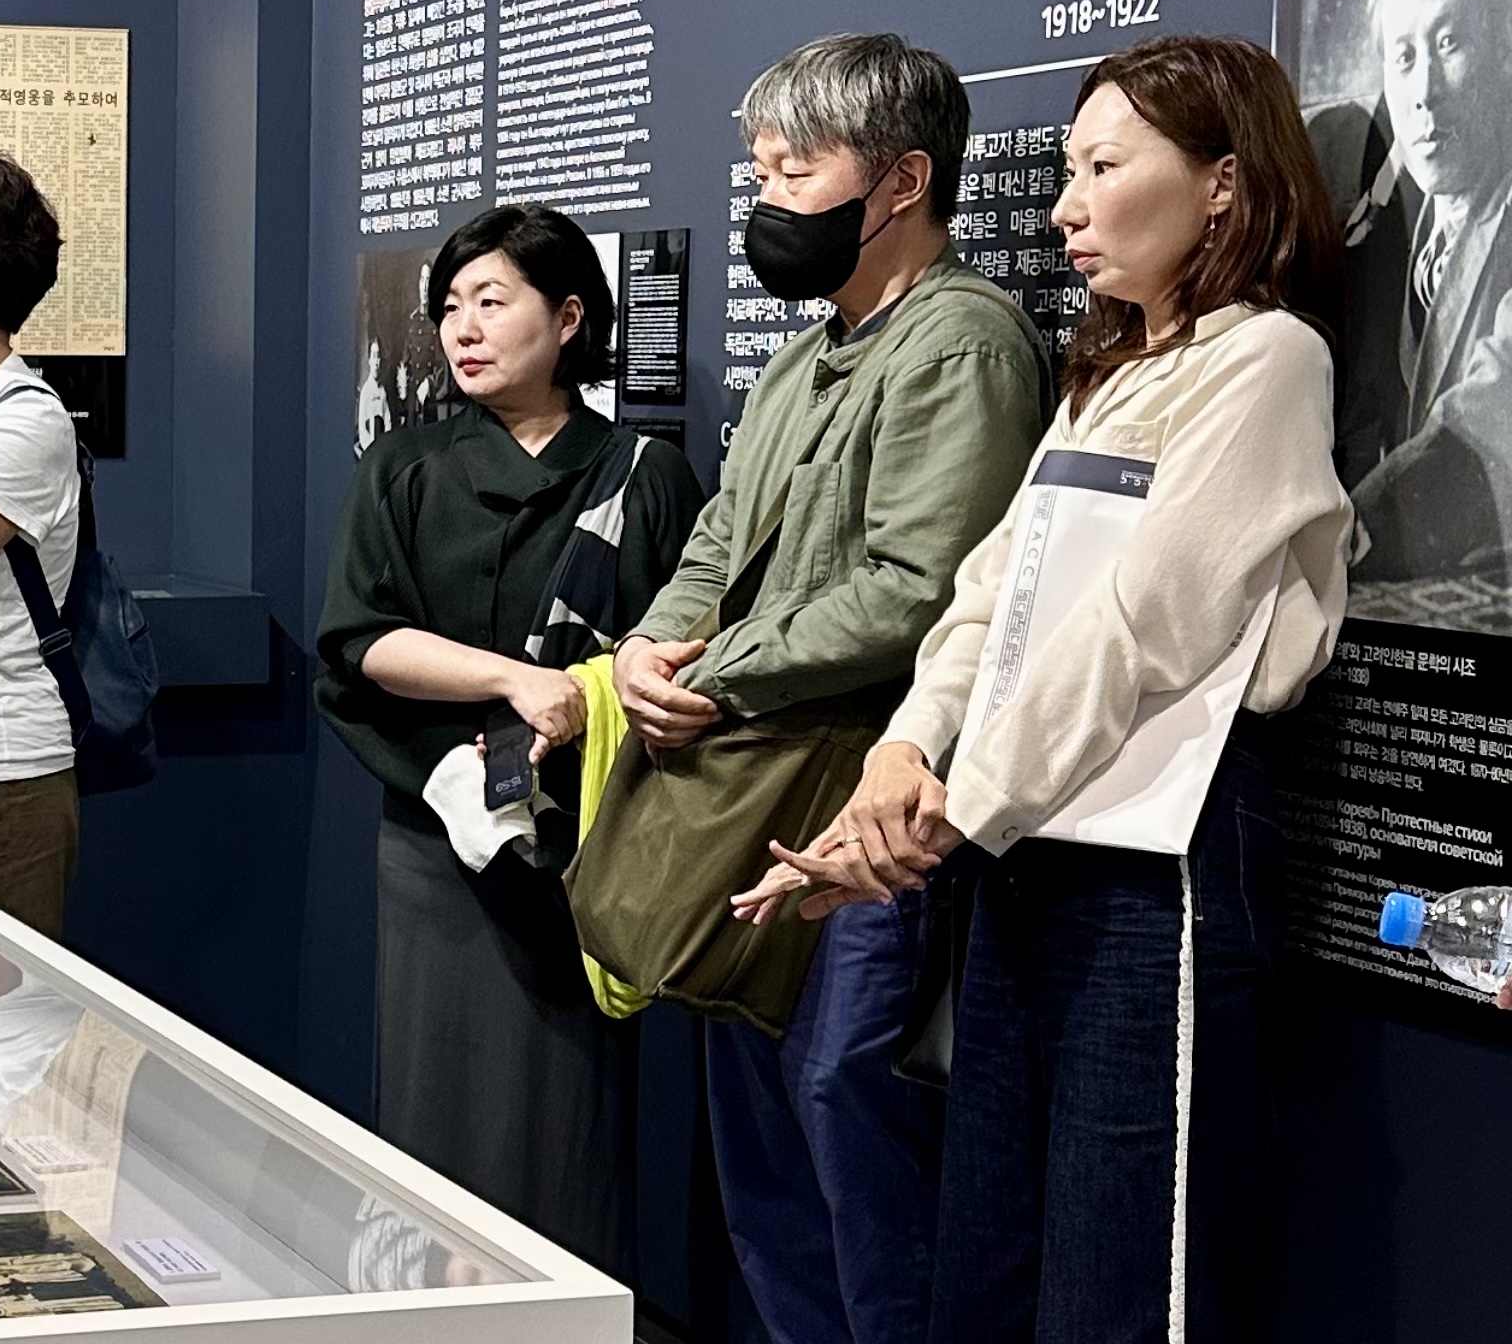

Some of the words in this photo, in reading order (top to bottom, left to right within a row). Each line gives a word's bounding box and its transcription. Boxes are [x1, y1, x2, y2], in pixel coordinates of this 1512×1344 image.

[63, 91, 118, 108] 추모하여
[1014, 126, 1058, 157] 홍범도,
[982, 172, 996, 199] 펜
[998, 169, 1024, 197] 대신
[1381, 807, 1454, 837] Протестные
[1455, 825, 1493, 845] стихи
[1370, 827, 1438, 853] основателя
[1440, 841, 1504, 868] советской
